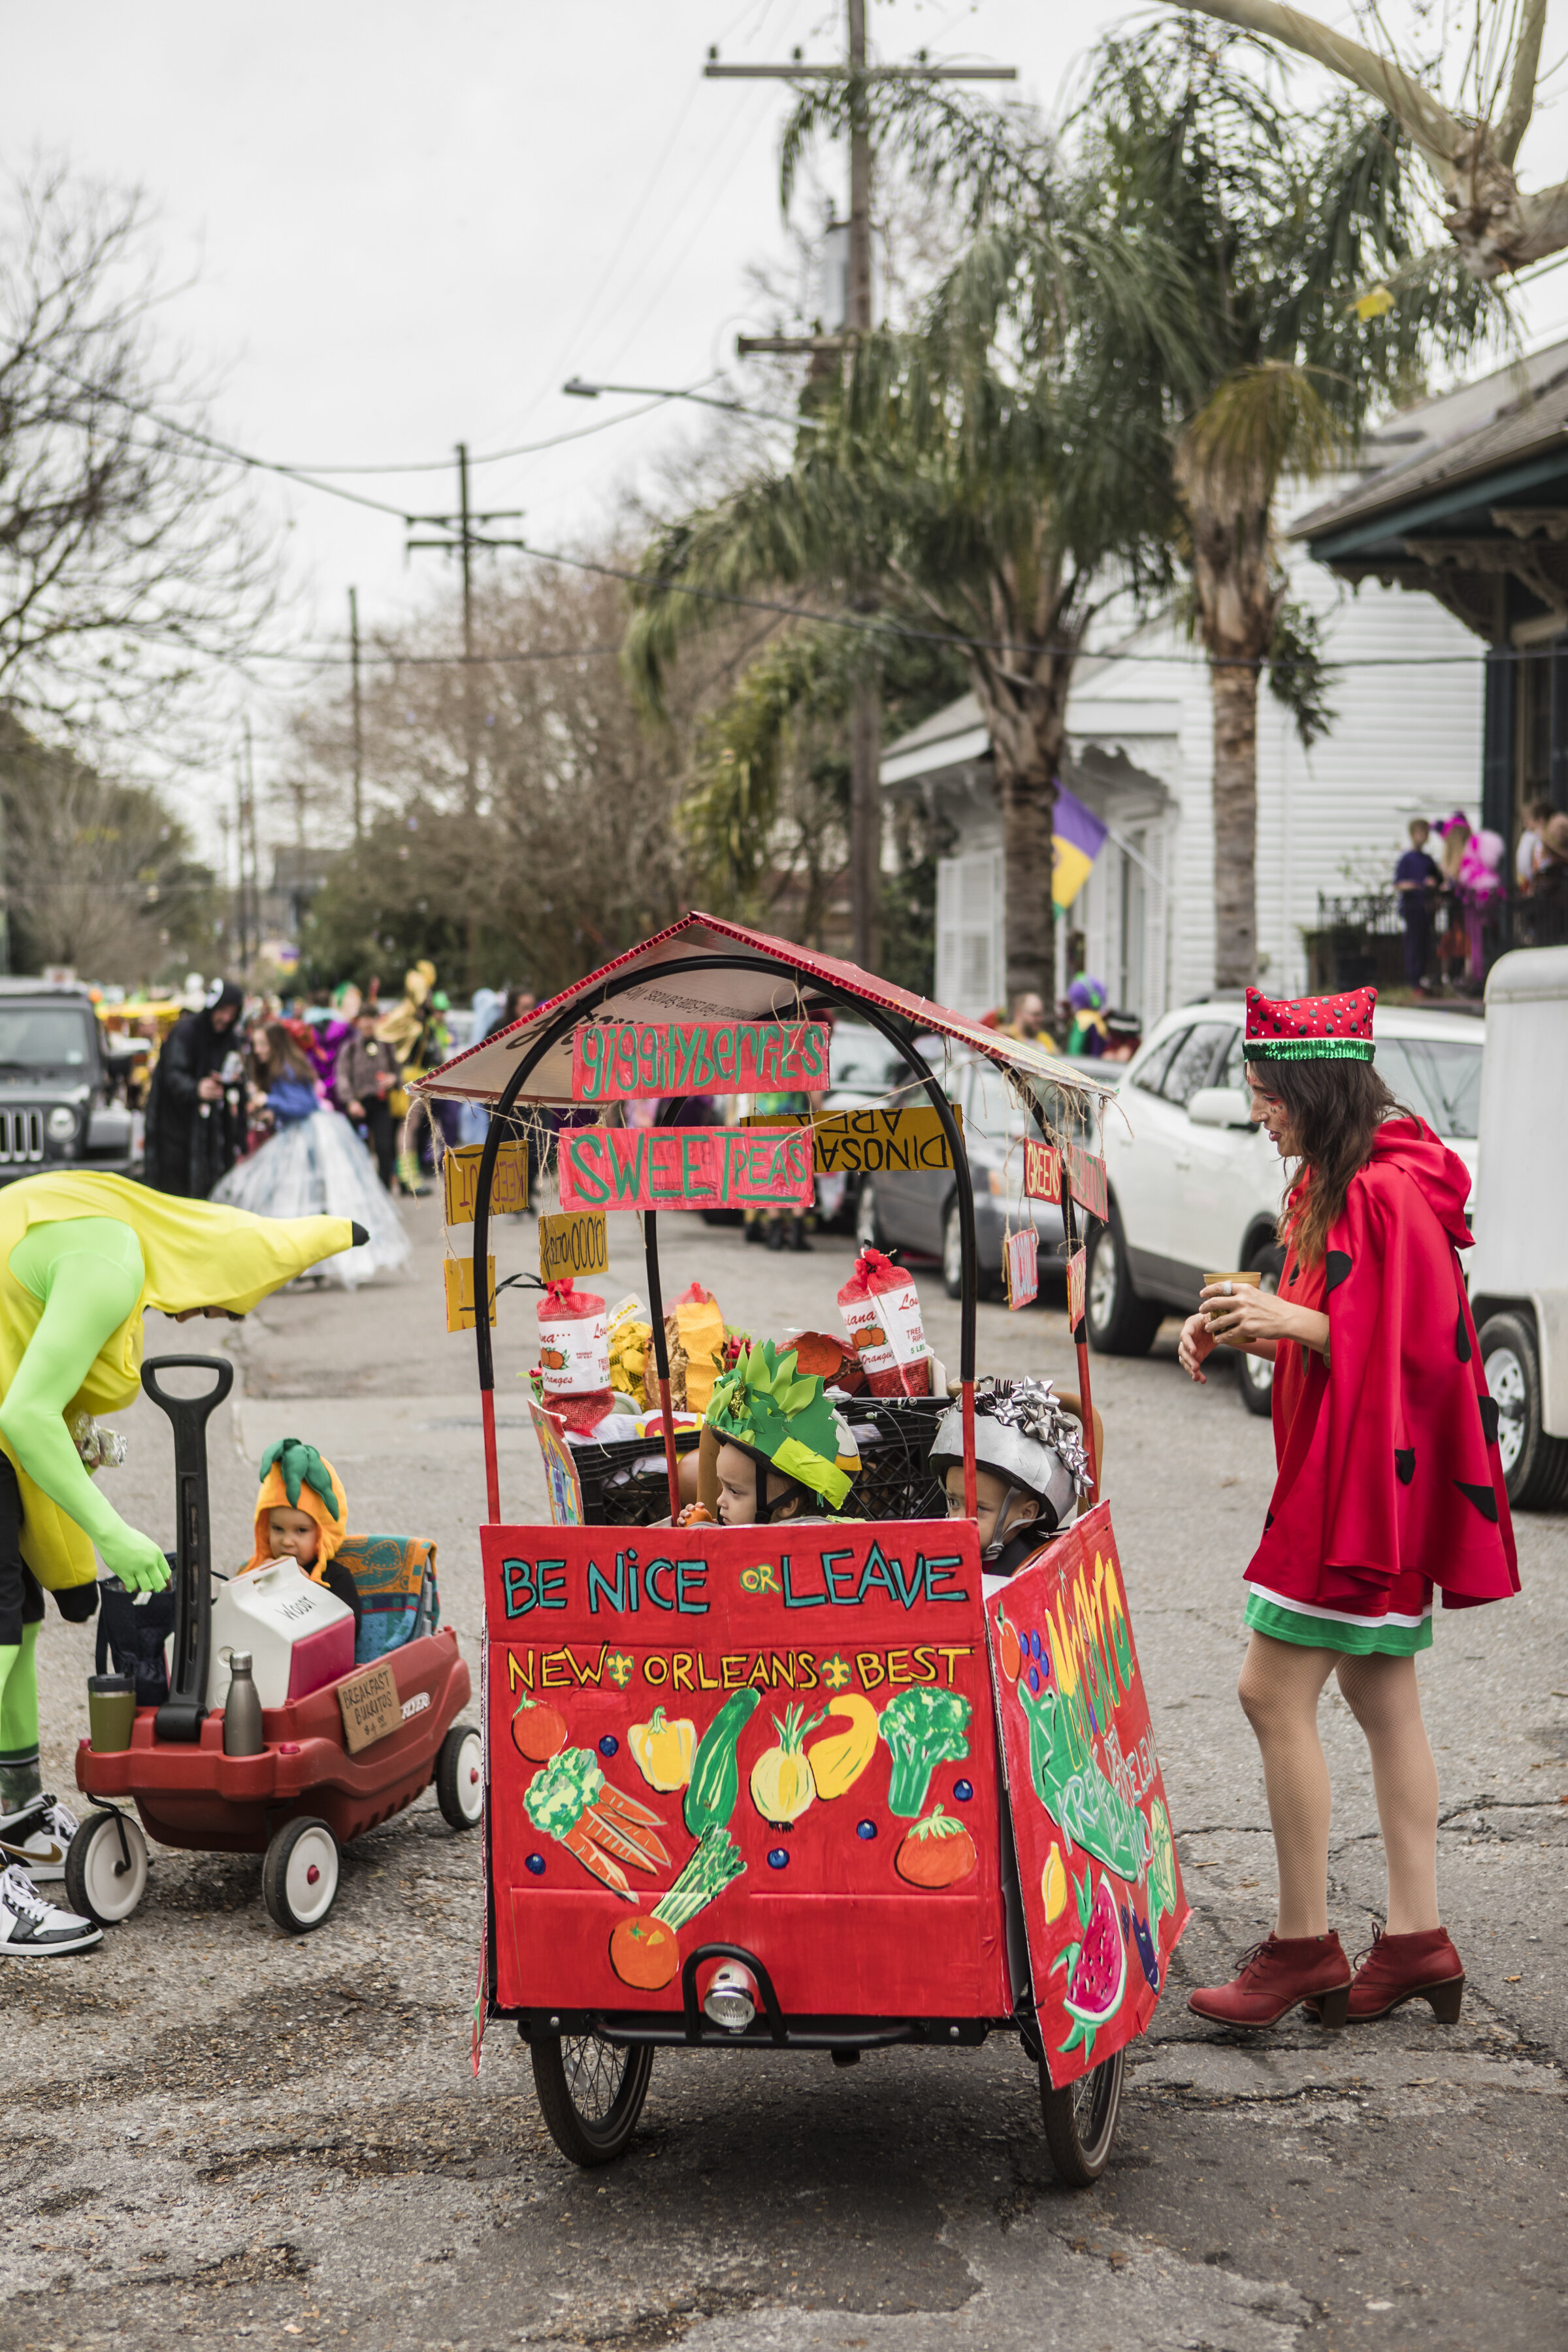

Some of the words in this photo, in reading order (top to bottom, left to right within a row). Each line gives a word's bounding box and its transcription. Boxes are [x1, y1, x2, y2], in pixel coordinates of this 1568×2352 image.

[676, 998, 706, 1013] Estate
[459, 1164, 478, 1207] UT
[493, 1158, 524, 1205] KEEP
[570, 1132, 745, 1204] SWEET
[734, 1142, 808, 1188] PEAS
[1027, 1143, 1061, 1201] GREENS
[906, 1326, 921, 1339] TREE
[502, 1557, 567, 1619] BE
[739, 1563, 783, 1595] OR
[781, 1539, 971, 1610] LEAVE
[507, 1641, 610, 1693] NEW
[643, 1650, 820, 1692] ORLEANS
[855, 1645, 975, 1690] BEST
[342, 1671, 391, 1709] BREAKFAST
[354, 1691, 393, 1725] BURRITOS
